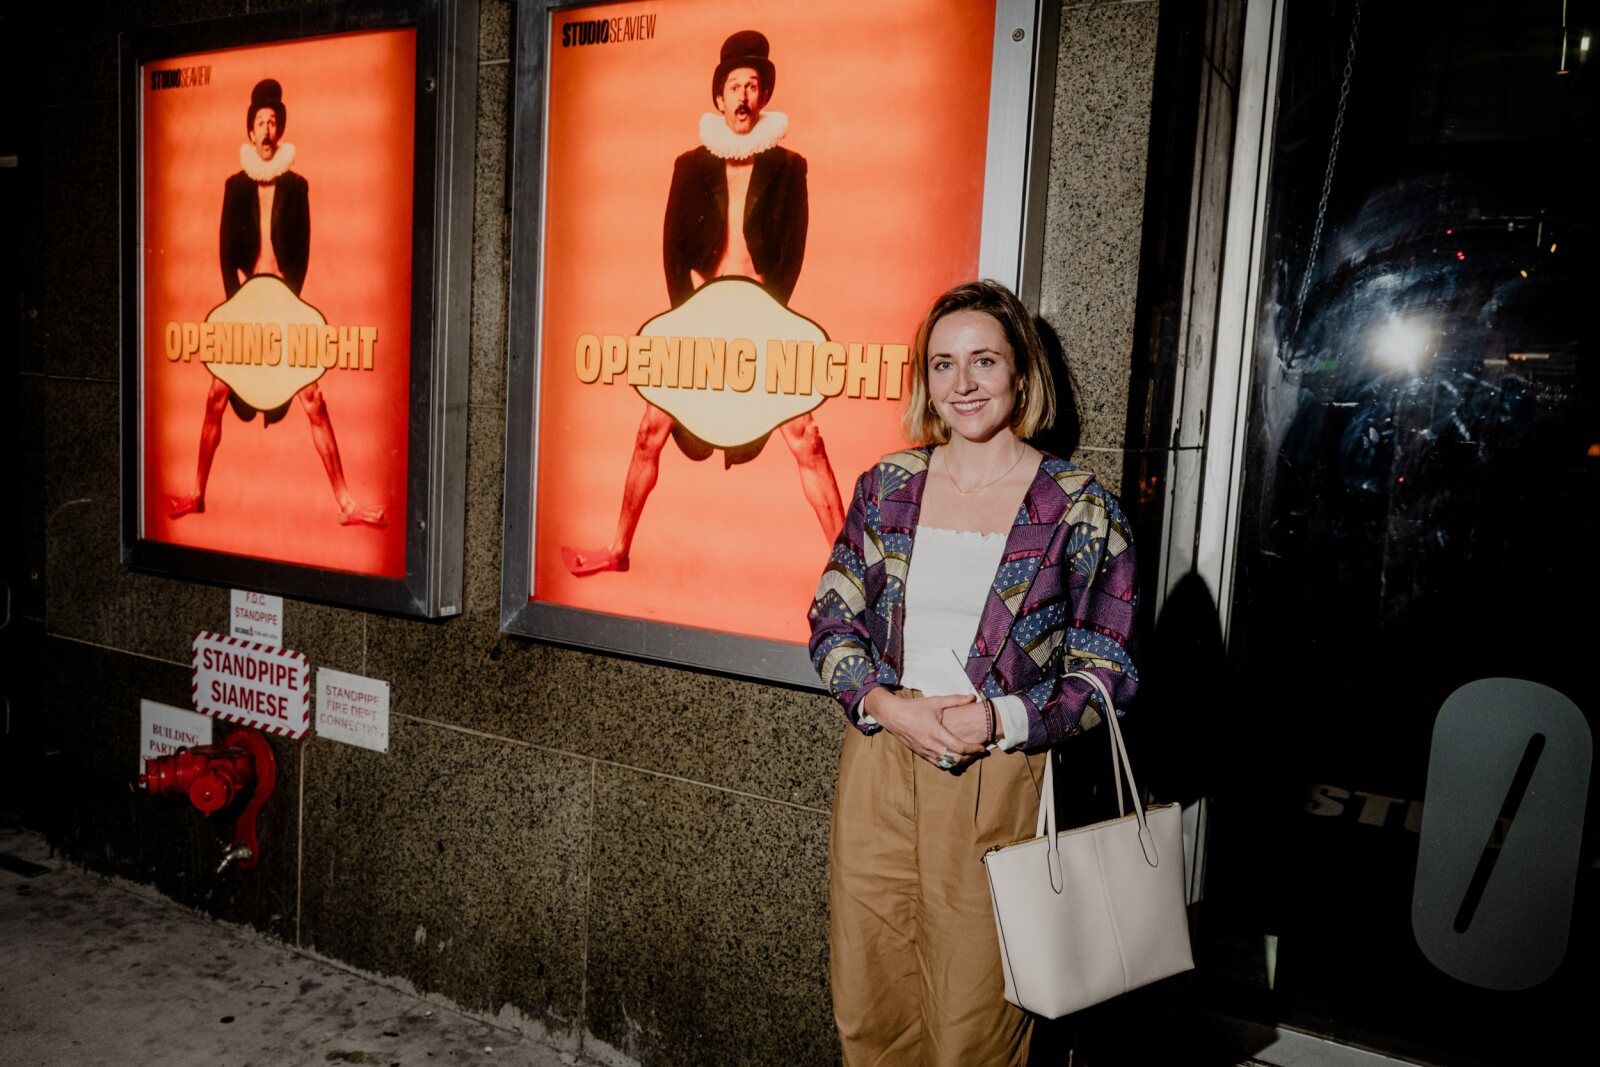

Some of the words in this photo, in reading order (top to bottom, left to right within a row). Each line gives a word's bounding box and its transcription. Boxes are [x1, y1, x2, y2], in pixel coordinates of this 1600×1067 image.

[165, 321, 282, 366] OPENING
[287, 323, 378, 371] NIGHT
[575, 333, 757, 392] OPENING
[765, 340, 909, 400] NIGHT
[234, 607, 278, 625] STANDPIPE
[203, 647, 298, 691] STANDPIPE
[211, 680, 289, 720] SIAMESE
[326, 700, 349, 715] FIRE
[350, 704, 378, 721] DEPT
[152, 723, 199, 745] BUILDING
